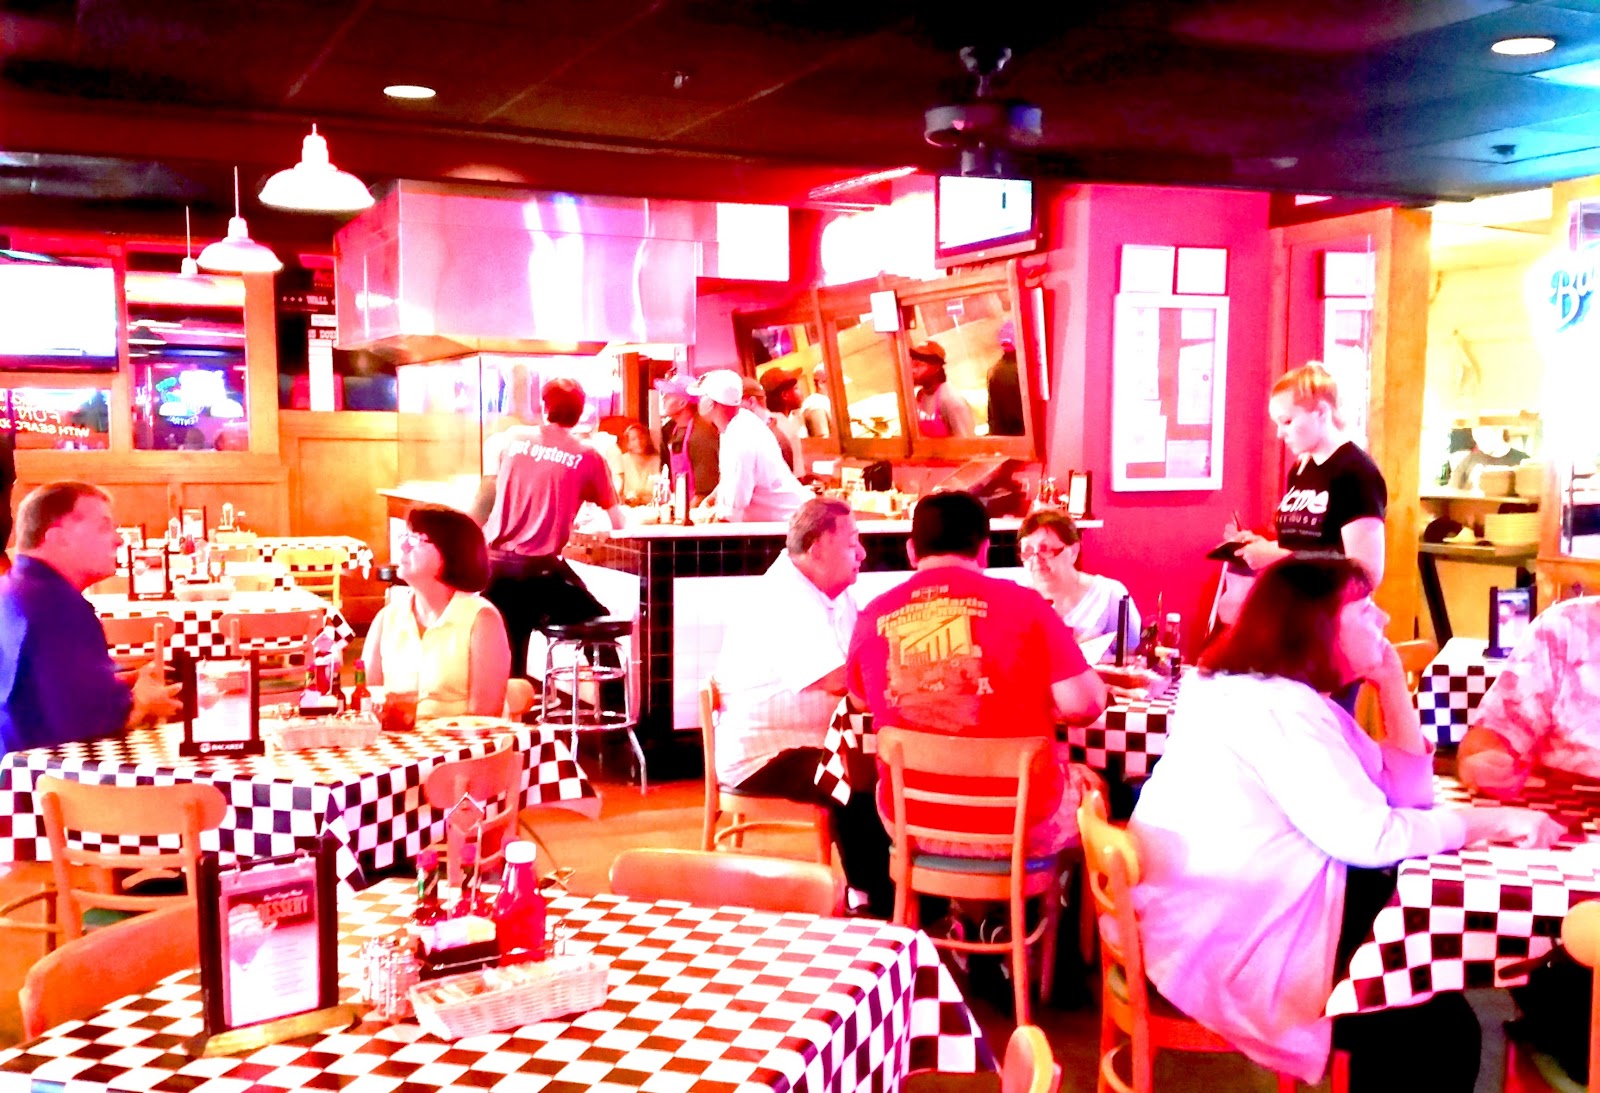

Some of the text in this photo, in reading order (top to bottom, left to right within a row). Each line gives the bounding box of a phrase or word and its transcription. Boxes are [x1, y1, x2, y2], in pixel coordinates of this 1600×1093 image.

[508, 439, 583, 470] got oysters?
[256, 895, 308, 922] DESSERT
